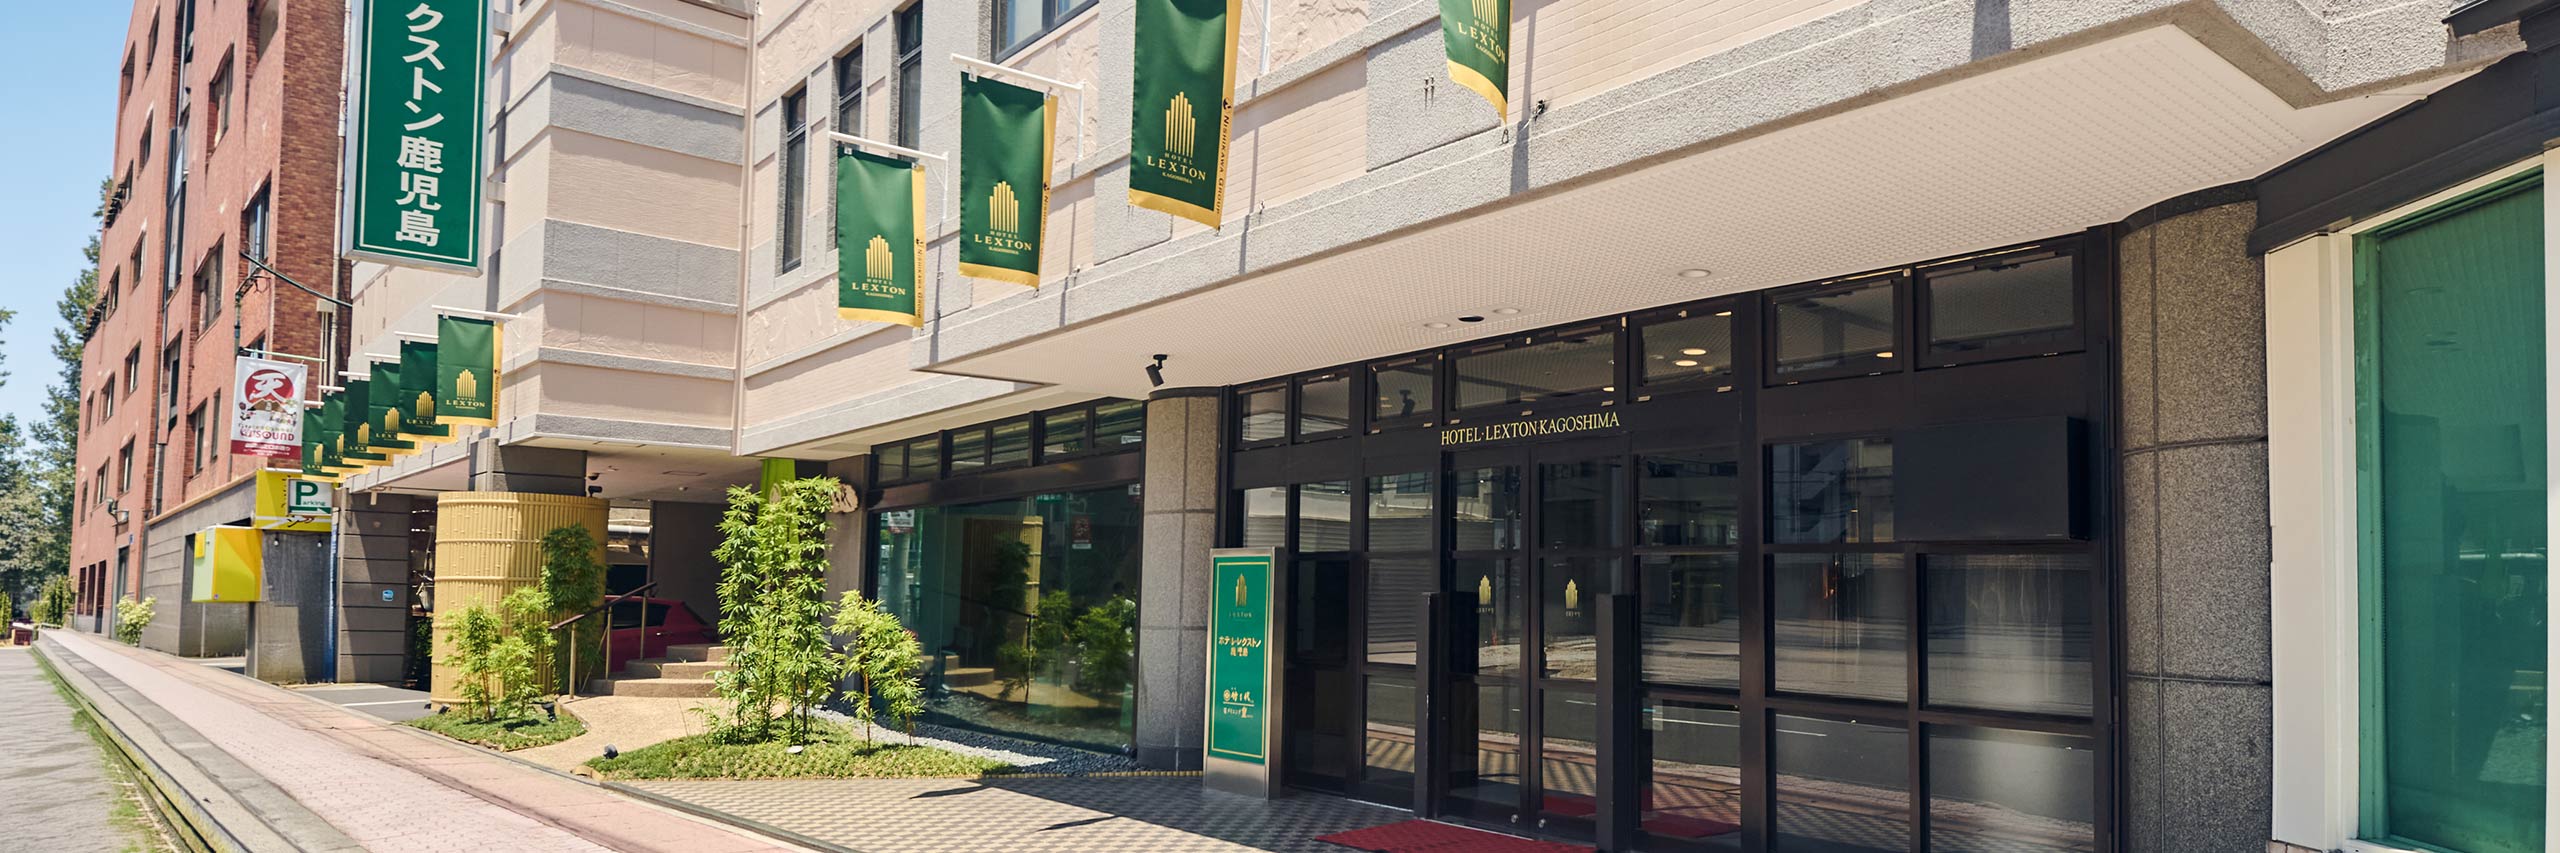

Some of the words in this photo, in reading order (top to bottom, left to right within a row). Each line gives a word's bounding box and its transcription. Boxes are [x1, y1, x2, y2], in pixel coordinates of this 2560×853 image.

[1458, 22, 1506, 64] LEXTON
[396, 2, 446, 247] クストン鹿児島
[1147, 155, 1206, 181] LEXTON
[1164, 152, 1193, 166] HOTEL
[974, 234, 1032, 251] LEXTON
[852, 282, 906, 295] LEXTON
